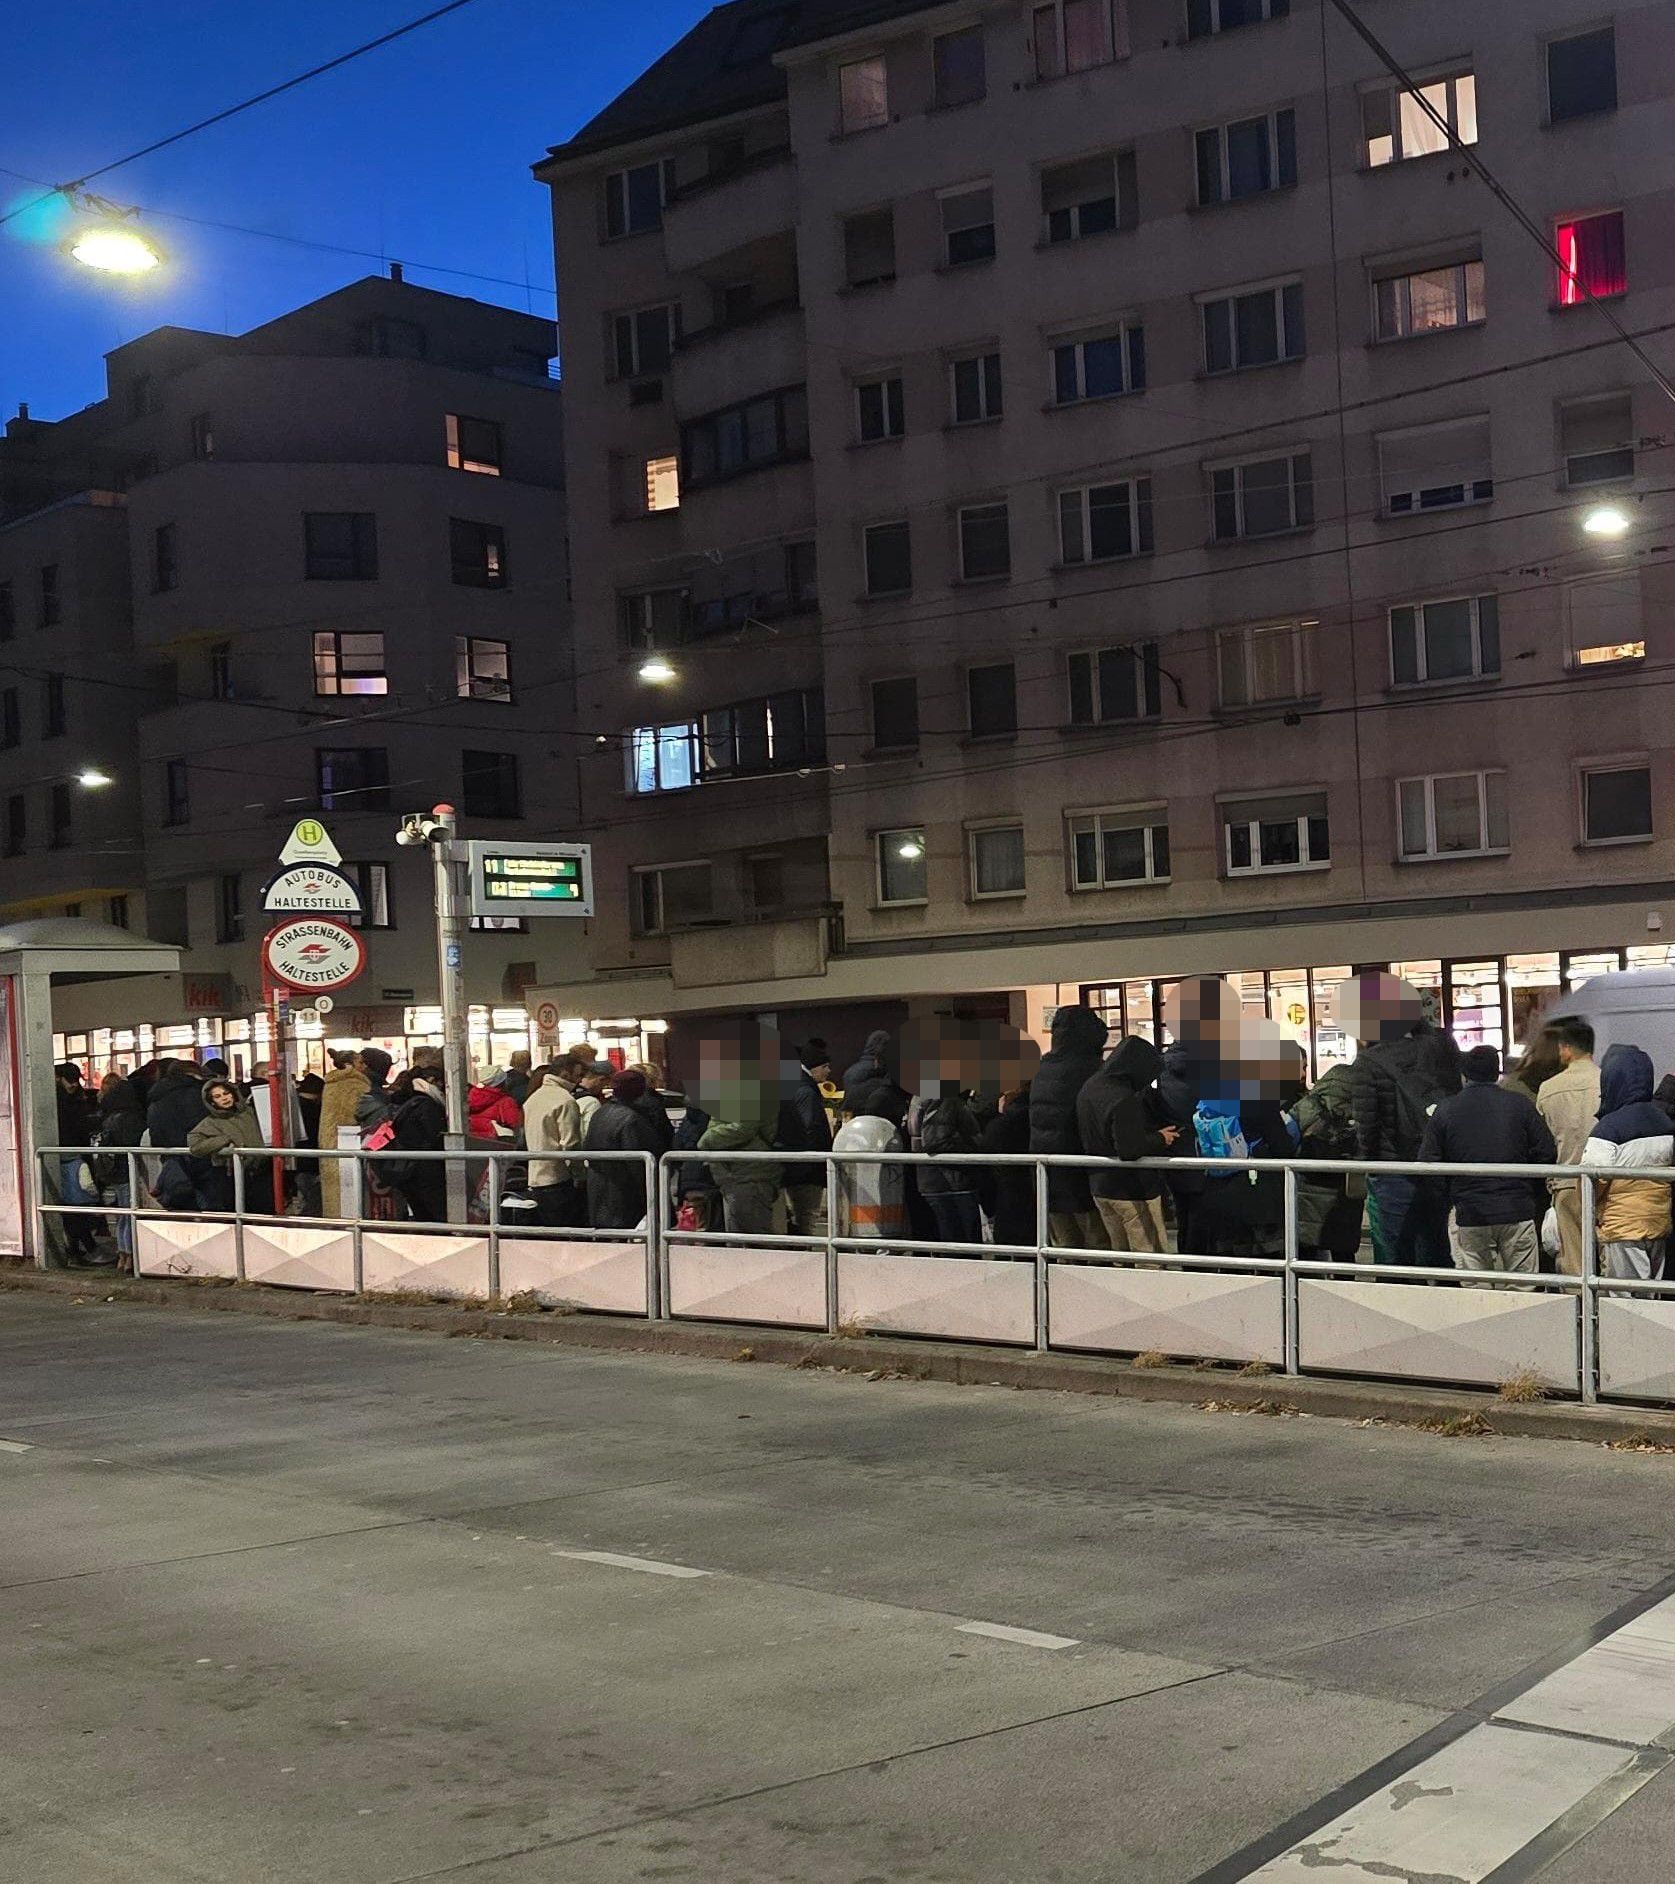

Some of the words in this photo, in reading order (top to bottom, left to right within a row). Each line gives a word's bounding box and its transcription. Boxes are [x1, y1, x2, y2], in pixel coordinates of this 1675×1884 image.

[302, 825, 317, 841] H
[284, 870, 342, 888] AUTOBUS
[274, 898, 352, 909] HALTESTELLE
[275, 925, 354, 951] STRASSENBAHN
[278, 960, 350, 982] HALTESTELLE
